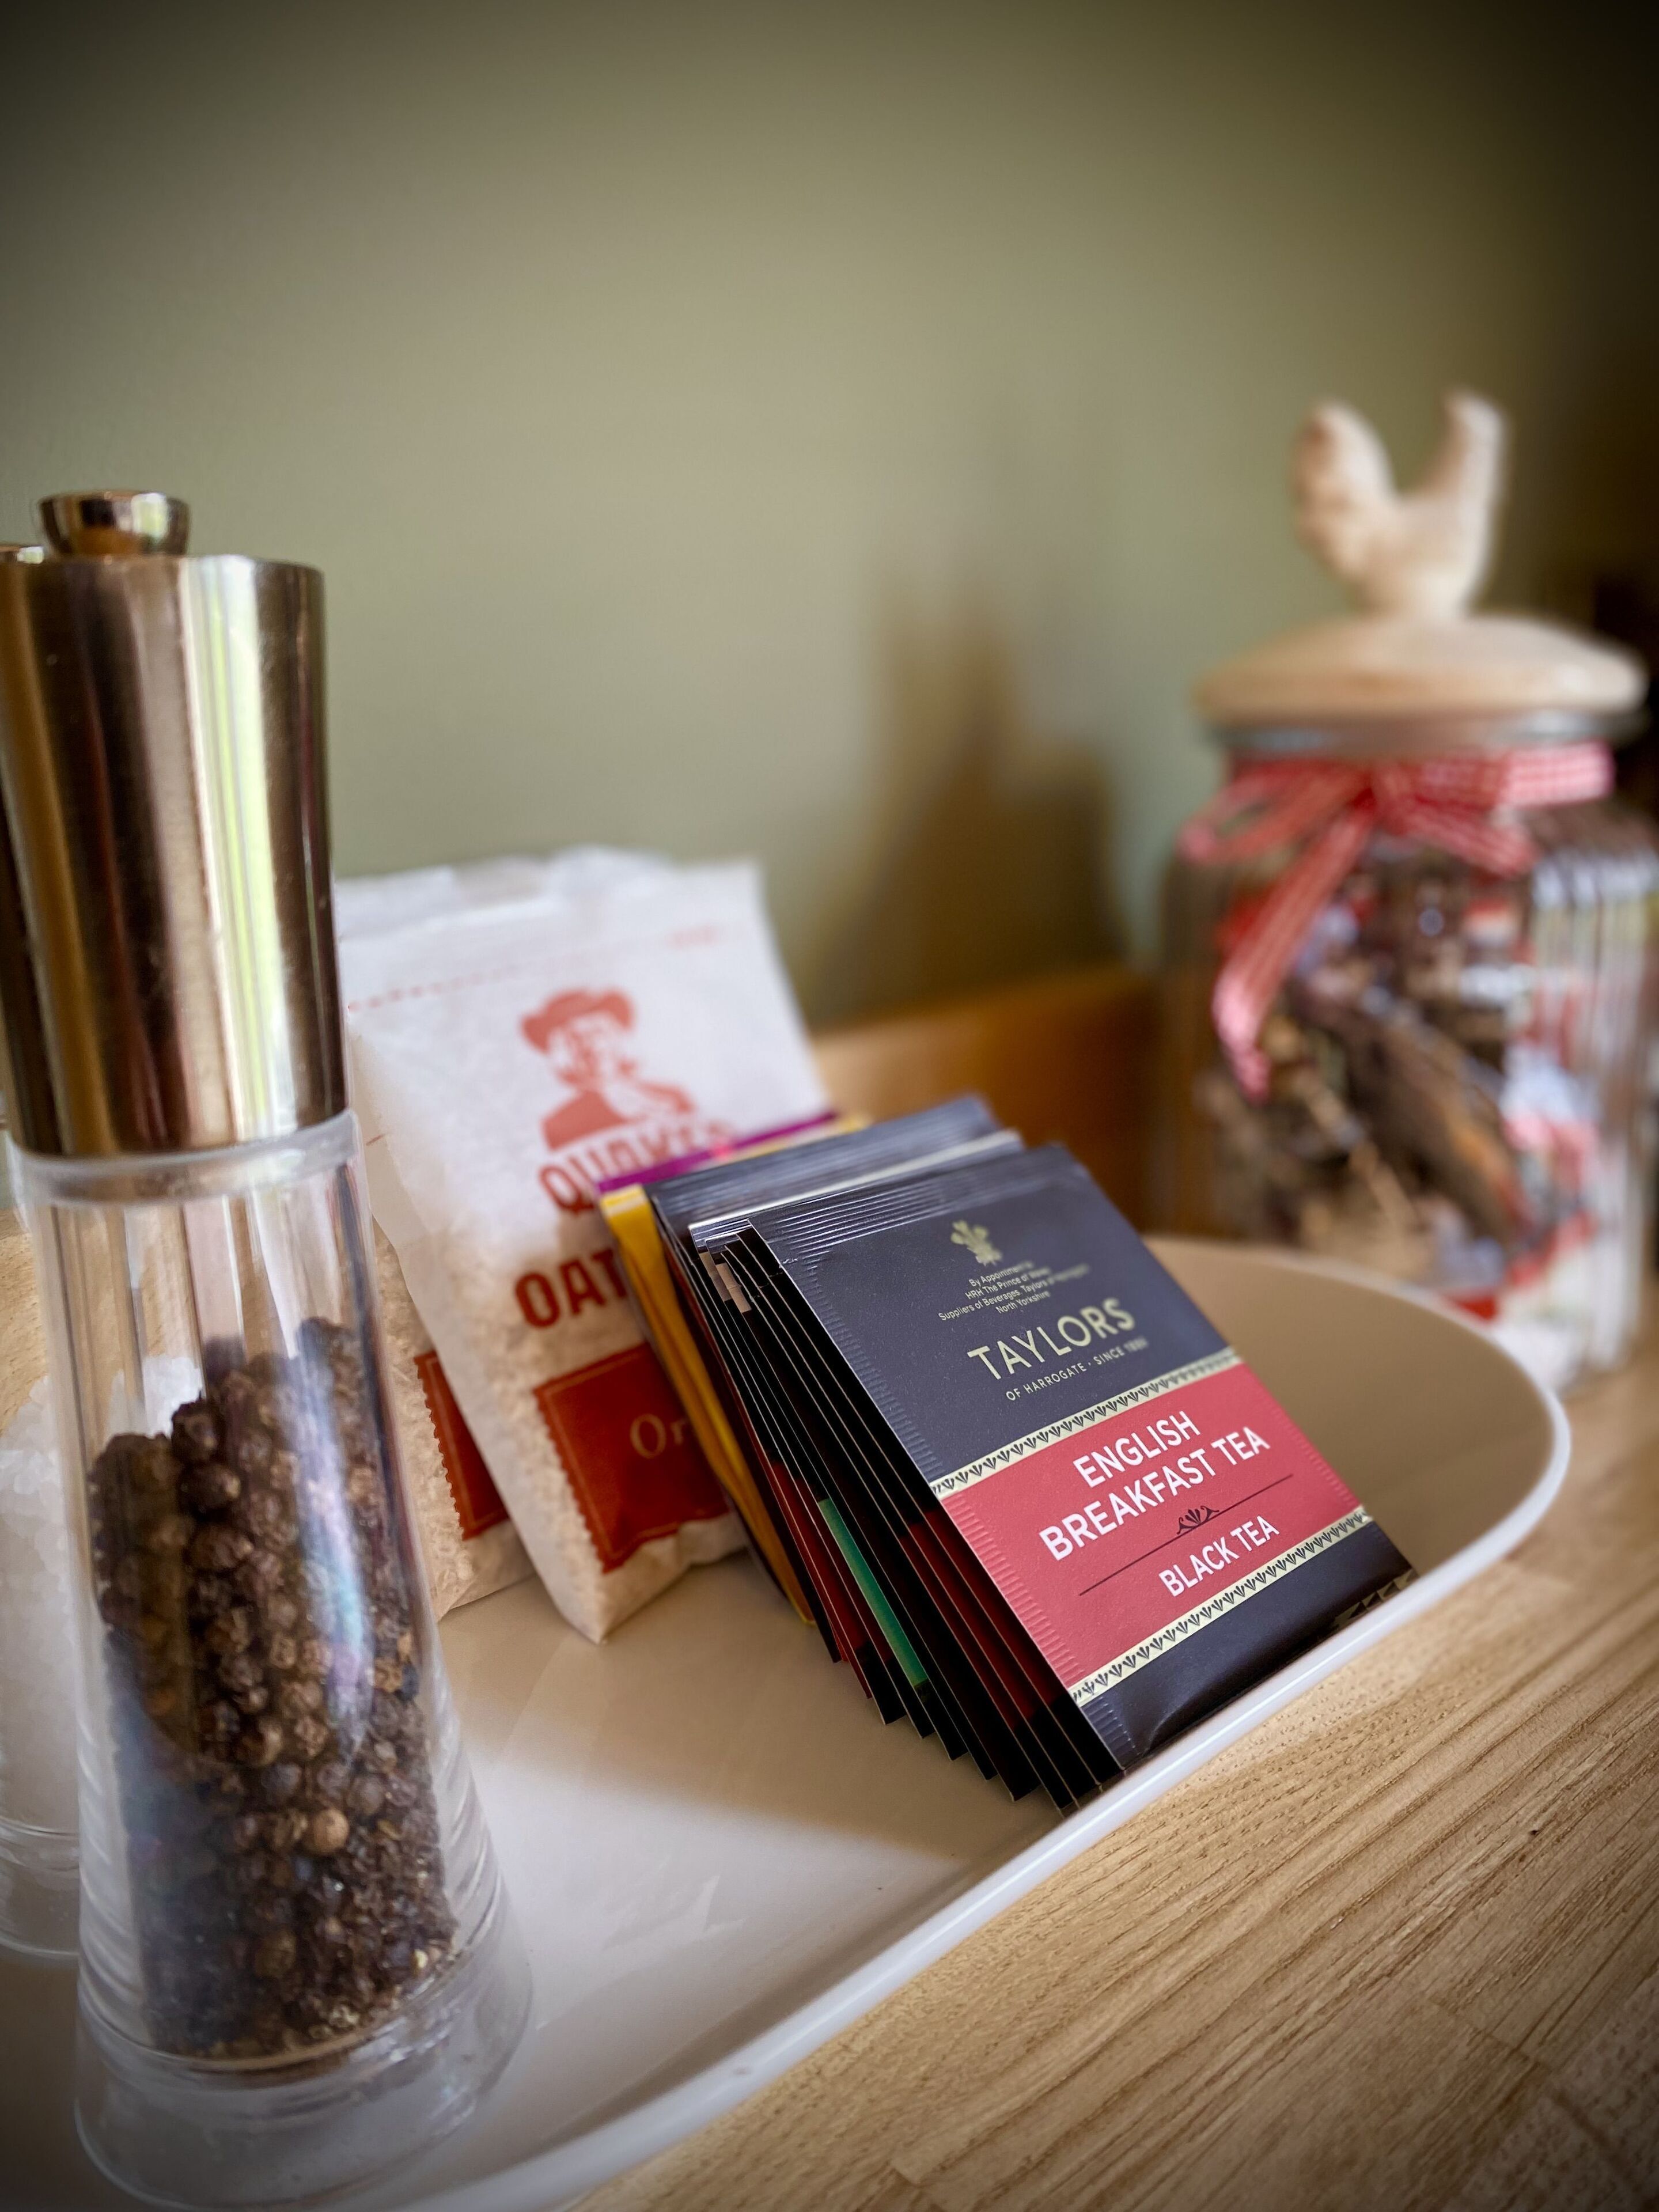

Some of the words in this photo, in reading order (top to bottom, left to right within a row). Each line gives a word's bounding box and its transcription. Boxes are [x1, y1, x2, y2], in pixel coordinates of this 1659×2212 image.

[539, 1123, 727, 1214] QUAK
[938, 1305, 975, 1321] Suppliers
[975, 1300, 983, 1309] of
[1020, 1279, 1048, 1293] Taylors
[965, 1288, 984, 1300] HRH
[982, 1285, 998, 1294] The
[997, 1277, 1021, 1289] Prince
[969, 1279, 982, 1287] By
[980, 1264, 1024, 1283] Appointme
[995, 1302, 1018, 1314] North
[1016, 1290, 1050, 1306] Yorkshire
[967, 1298, 1135, 1380] TAYLORS
[1006, 1388, 1021, 1401] OF
[1023, 1362, 1087, 1394] HARROGATE
[1093, 1346, 1124, 1365] SINCE
[1073, 1411, 1200, 1488] ENGLISH
[1039, 1449, 1216, 1561] BREAKFAST
[1211, 1426, 1271, 1465] TEA
[1158, 1536, 1239, 1597] BLACK
[1230, 1516, 1280, 1551] TEA
